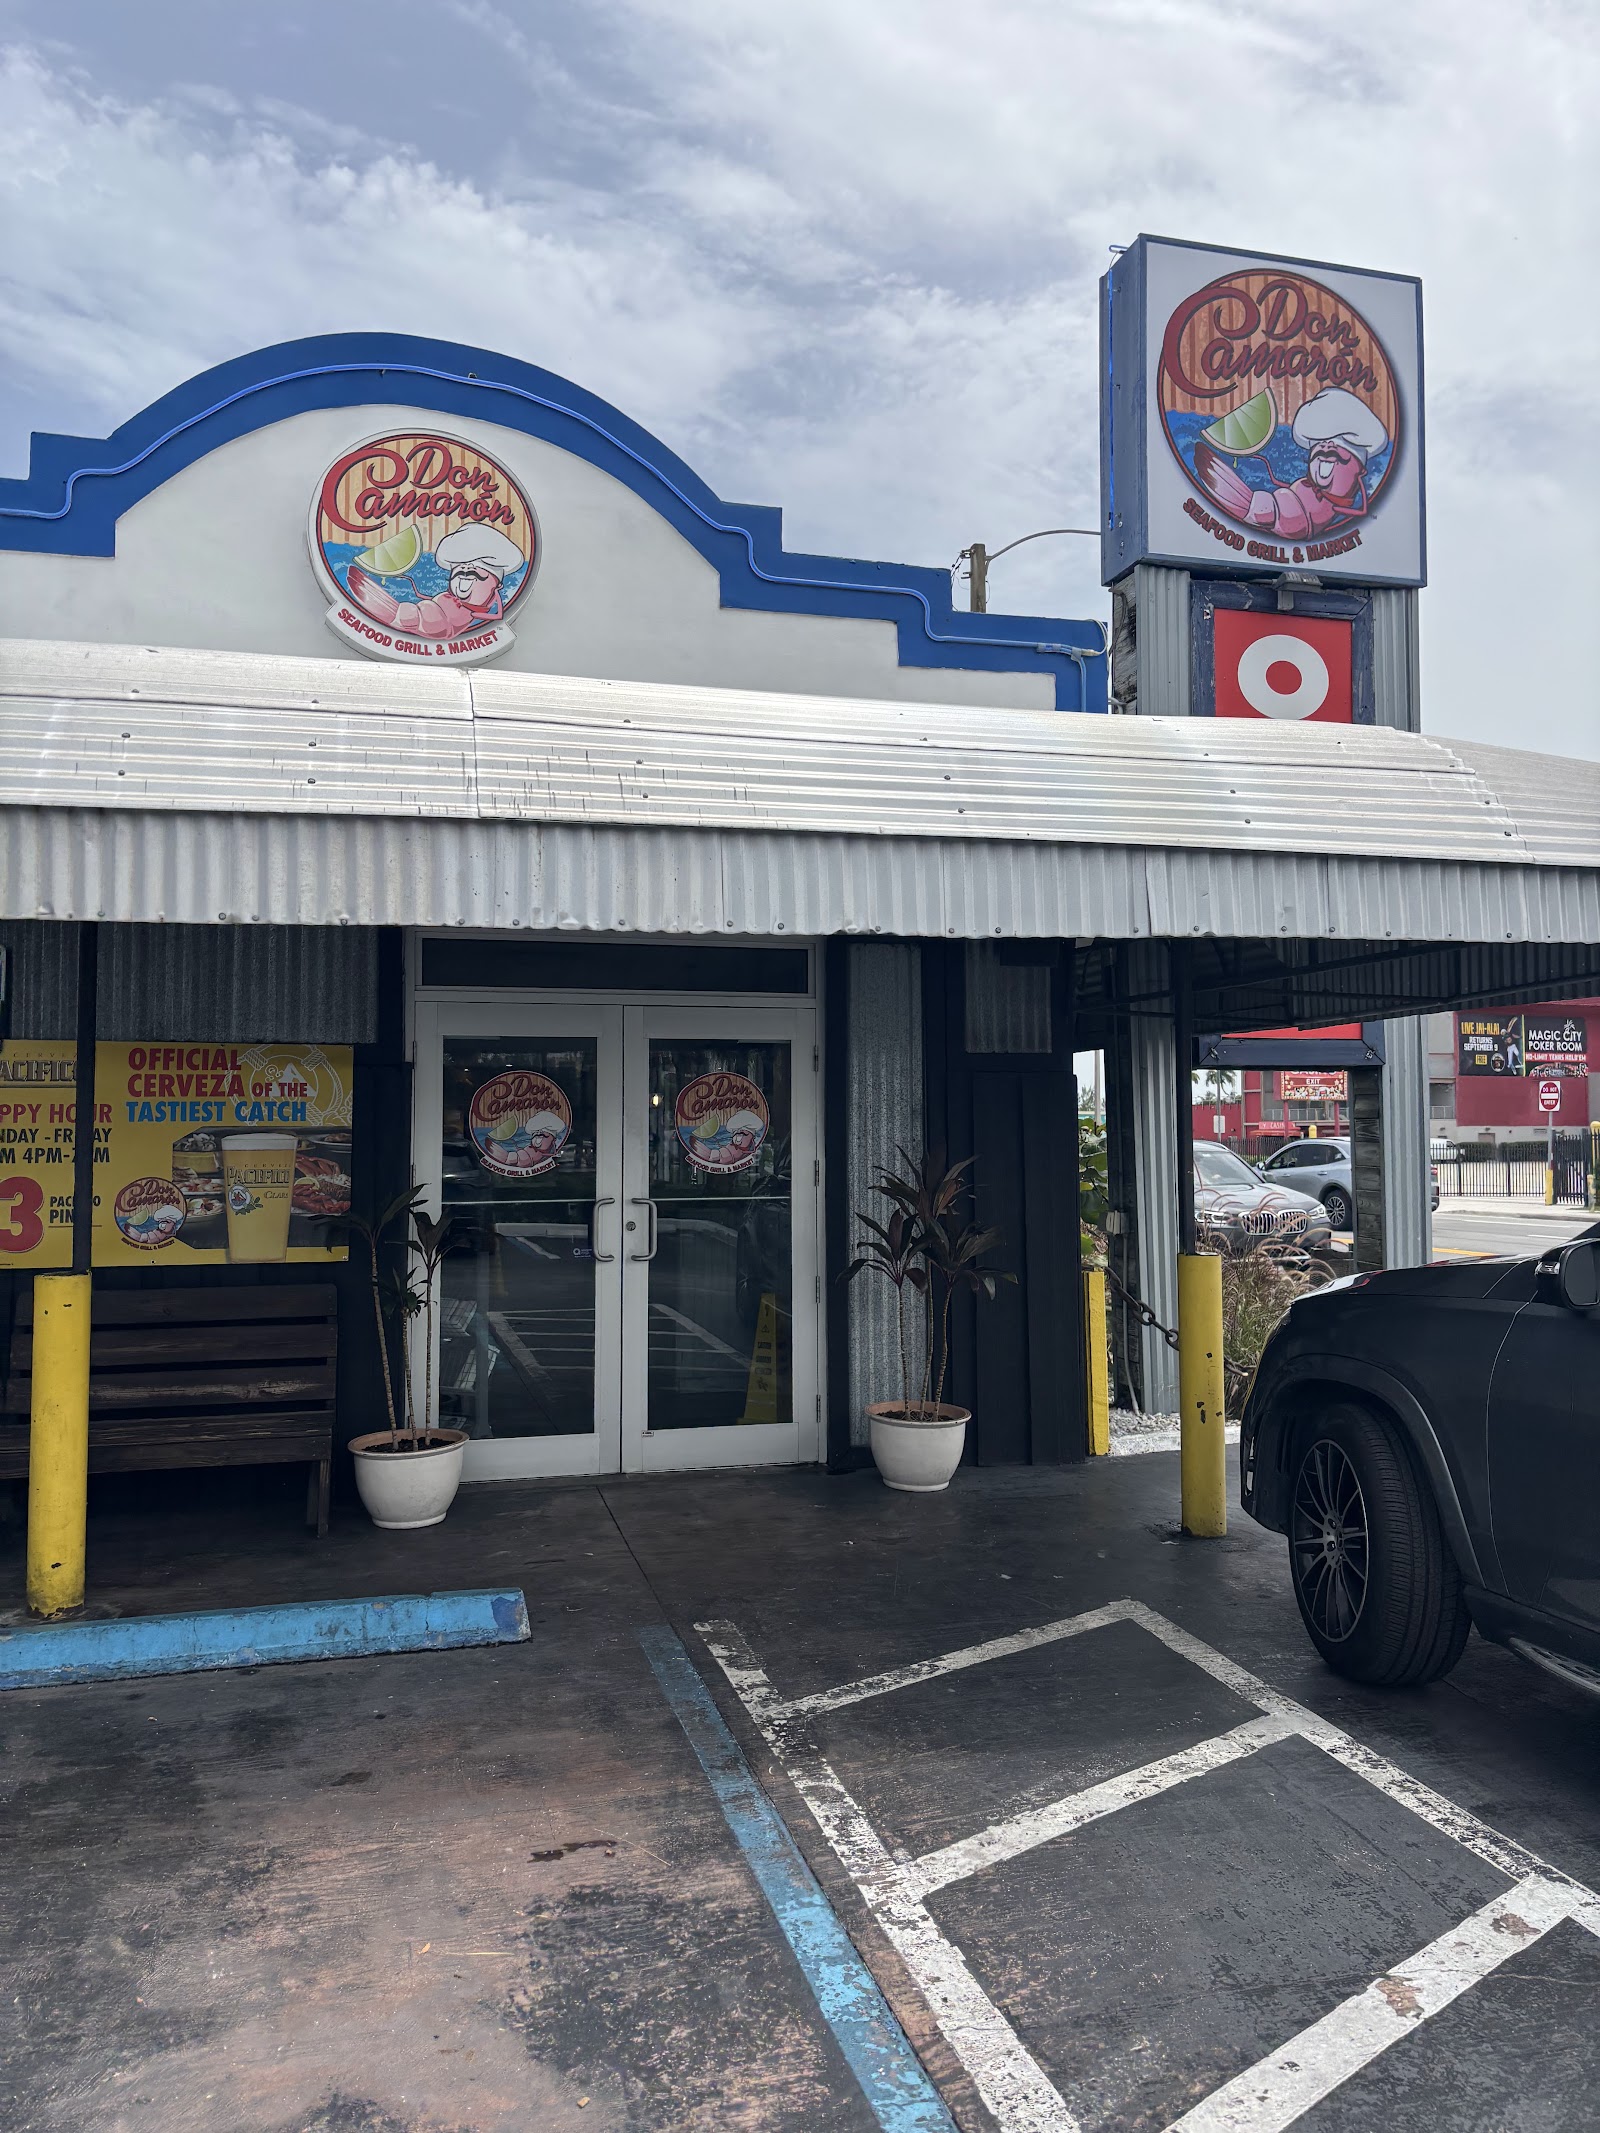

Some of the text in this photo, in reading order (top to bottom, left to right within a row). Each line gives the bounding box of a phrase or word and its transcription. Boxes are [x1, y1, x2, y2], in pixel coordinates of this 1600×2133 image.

[1257, 279, 1361, 346] Don
[1163, 287, 1378, 398] Camarón
[406, 441, 500, 492] Don
[321, 447, 516, 533] Camarón
[1183, 497, 1363, 564] SEAFOOD GRILL & MARKET
[337, 607, 499, 657] SEAFOOD GRILL & MARKET
[1461, 1022, 1499, 1035] LIVE JAI-ALAI
[1529, 1030, 1582, 1042] MAGIC CITY
[1464, 1043, 1493, 1051] SEPTEMBER
[1528, 1041, 1583, 1052] POKER ROOM
[128, 1047, 242, 1071] OFFICIAL
[128, 1074, 308, 1097] CERVEZA OF THE
[511, 1075, 553, 1098] Don
[712, 1075, 752, 1098] Don
[49, 1103, 112, 1123] HOR
[126, 1101, 307, 1122] TASTIEST CATCH
[481, 1158, 506, 1174] SEAFOOD
[507, 1169, 525, 1177] GRILL
[531, 1161, 556, 1175] MARKET
[144, 1179, 175, 1196] Don
